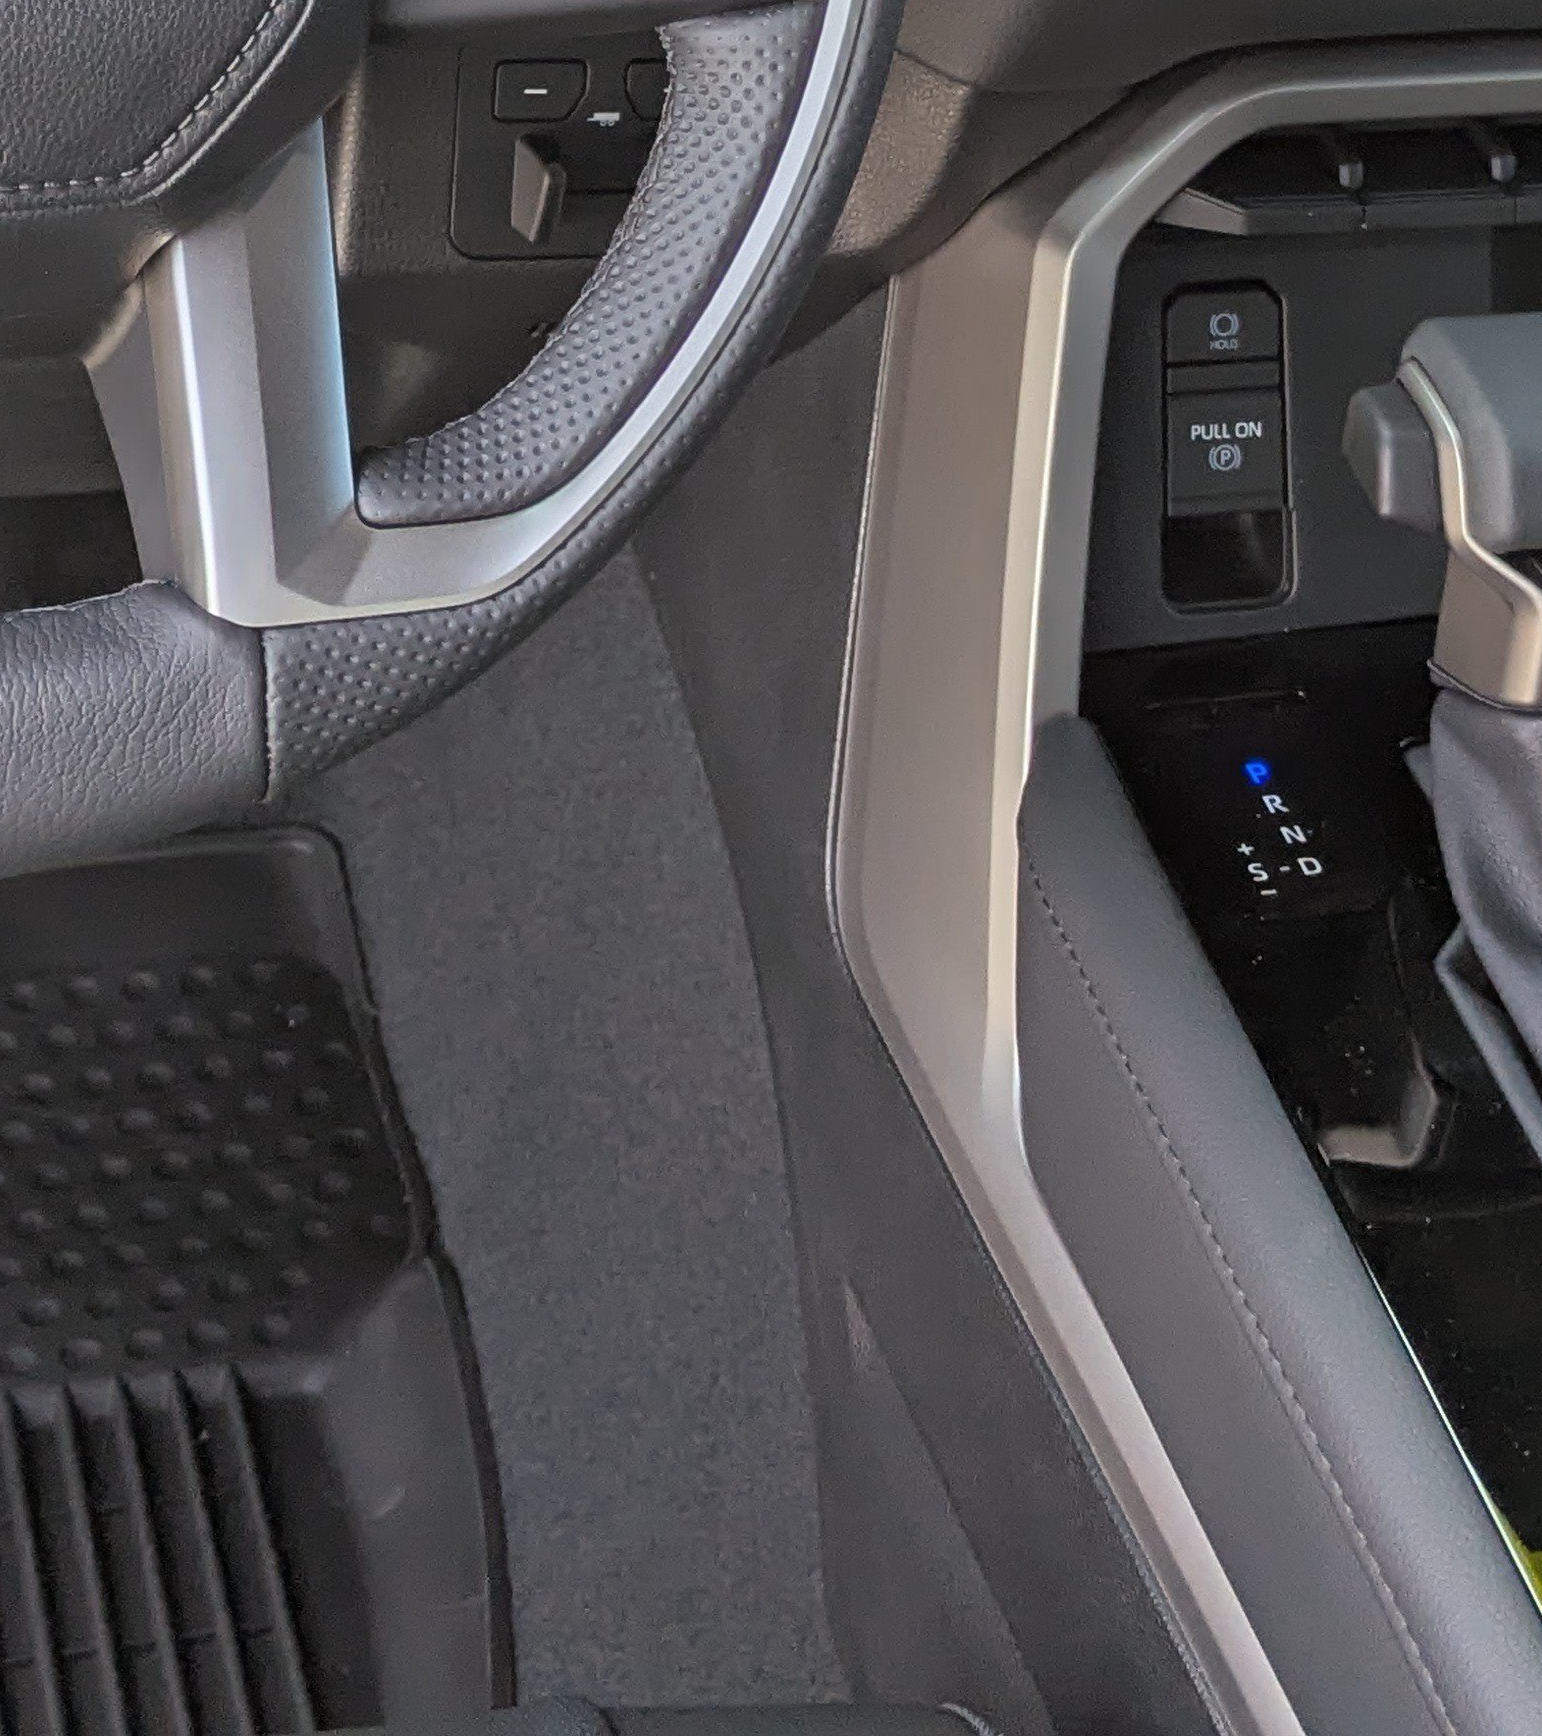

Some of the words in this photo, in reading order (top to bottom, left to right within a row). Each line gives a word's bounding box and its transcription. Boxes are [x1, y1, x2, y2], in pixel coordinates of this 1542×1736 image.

[1190, 422, 1231, 441] PULL
[1235, 421, 1263, 438] ON
[1245, 762, 1268, 782] P
[1263, 794, 1289, 814] R
[1280, 824, 1307, 845] N
[1247, 863, 1268, 883] S
[1299, 856, 1323, 877] D
